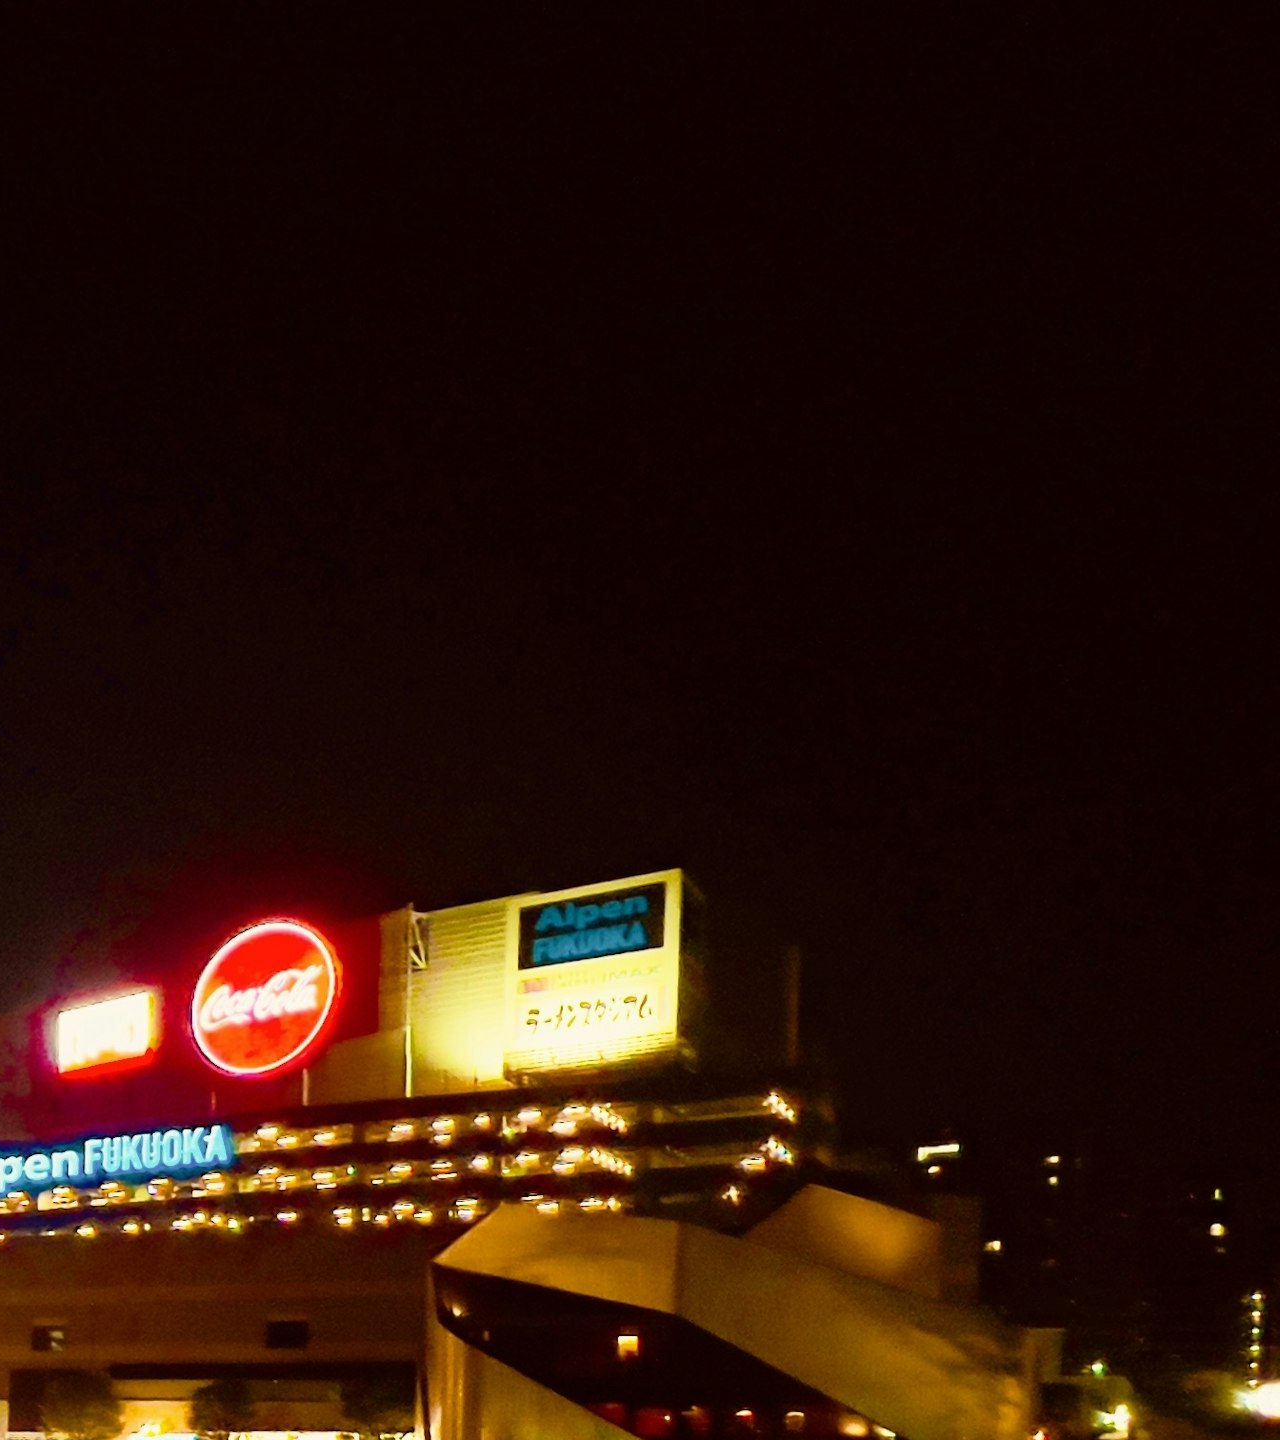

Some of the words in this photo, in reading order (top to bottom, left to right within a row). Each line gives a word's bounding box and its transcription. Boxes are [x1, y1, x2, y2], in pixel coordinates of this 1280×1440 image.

[535, 894, 649, 931] Alpen
[532, 921, 648, 966] FUKUOKA
[200, 964, 323, 1031] Coca-Cola
[83, 1125, 228, 1175] FUKUOKA
